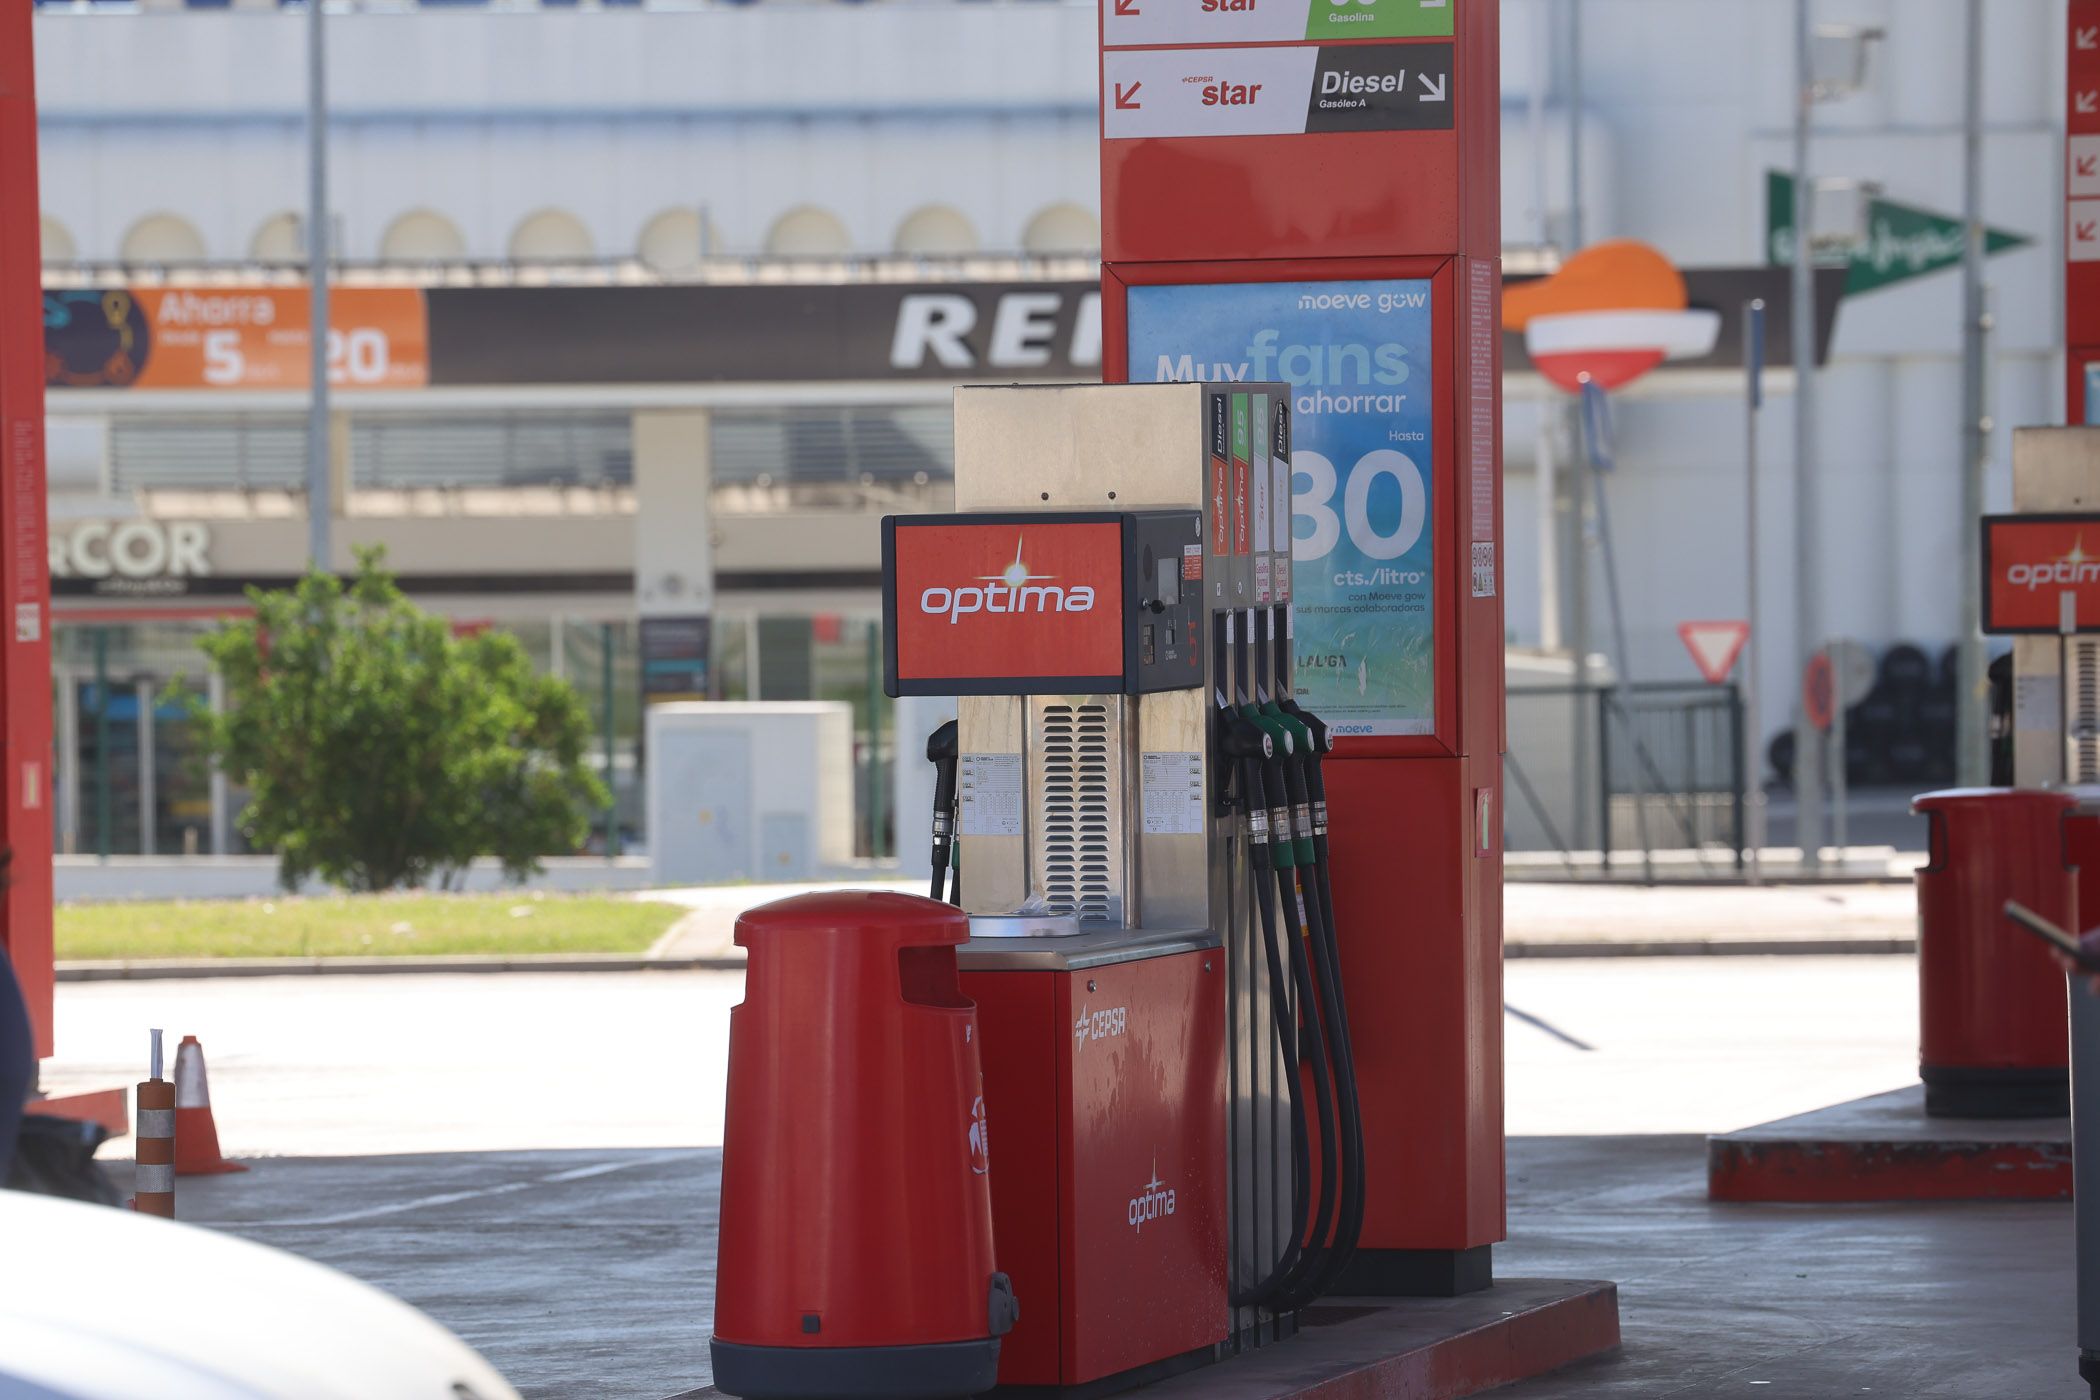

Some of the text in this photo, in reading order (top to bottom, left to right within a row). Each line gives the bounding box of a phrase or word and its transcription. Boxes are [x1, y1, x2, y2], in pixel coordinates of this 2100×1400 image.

[1328, 13, 1375, 22] Gasolina
[1201, 80, 1262, 106] star
[1321, 69, 1405, 94] Diesel
[1319, 99, 1366, 109] Gasóleo A
[157, 291, 276, 325] Ahorra
[1298, 293, 1371, 310] moeve
[203, 329, 246, 384] 5
[1246, 328, 1410, 387] fans
[1296, 389, 1408, 414] ahorrar
[1389, 430, 1425, 441] Hasta
[920, 582, 1095, 625] optima
[1296, 603, 1425, 614] sus marcas colaboradoras
[1348, 592, 1426, 603] con Moeve gow
[1336, 725, 1373, 733] moeve
[1091, 1006, 1126, 1040] CEPSA
[1128, 1188, 1176, 1234] optima
